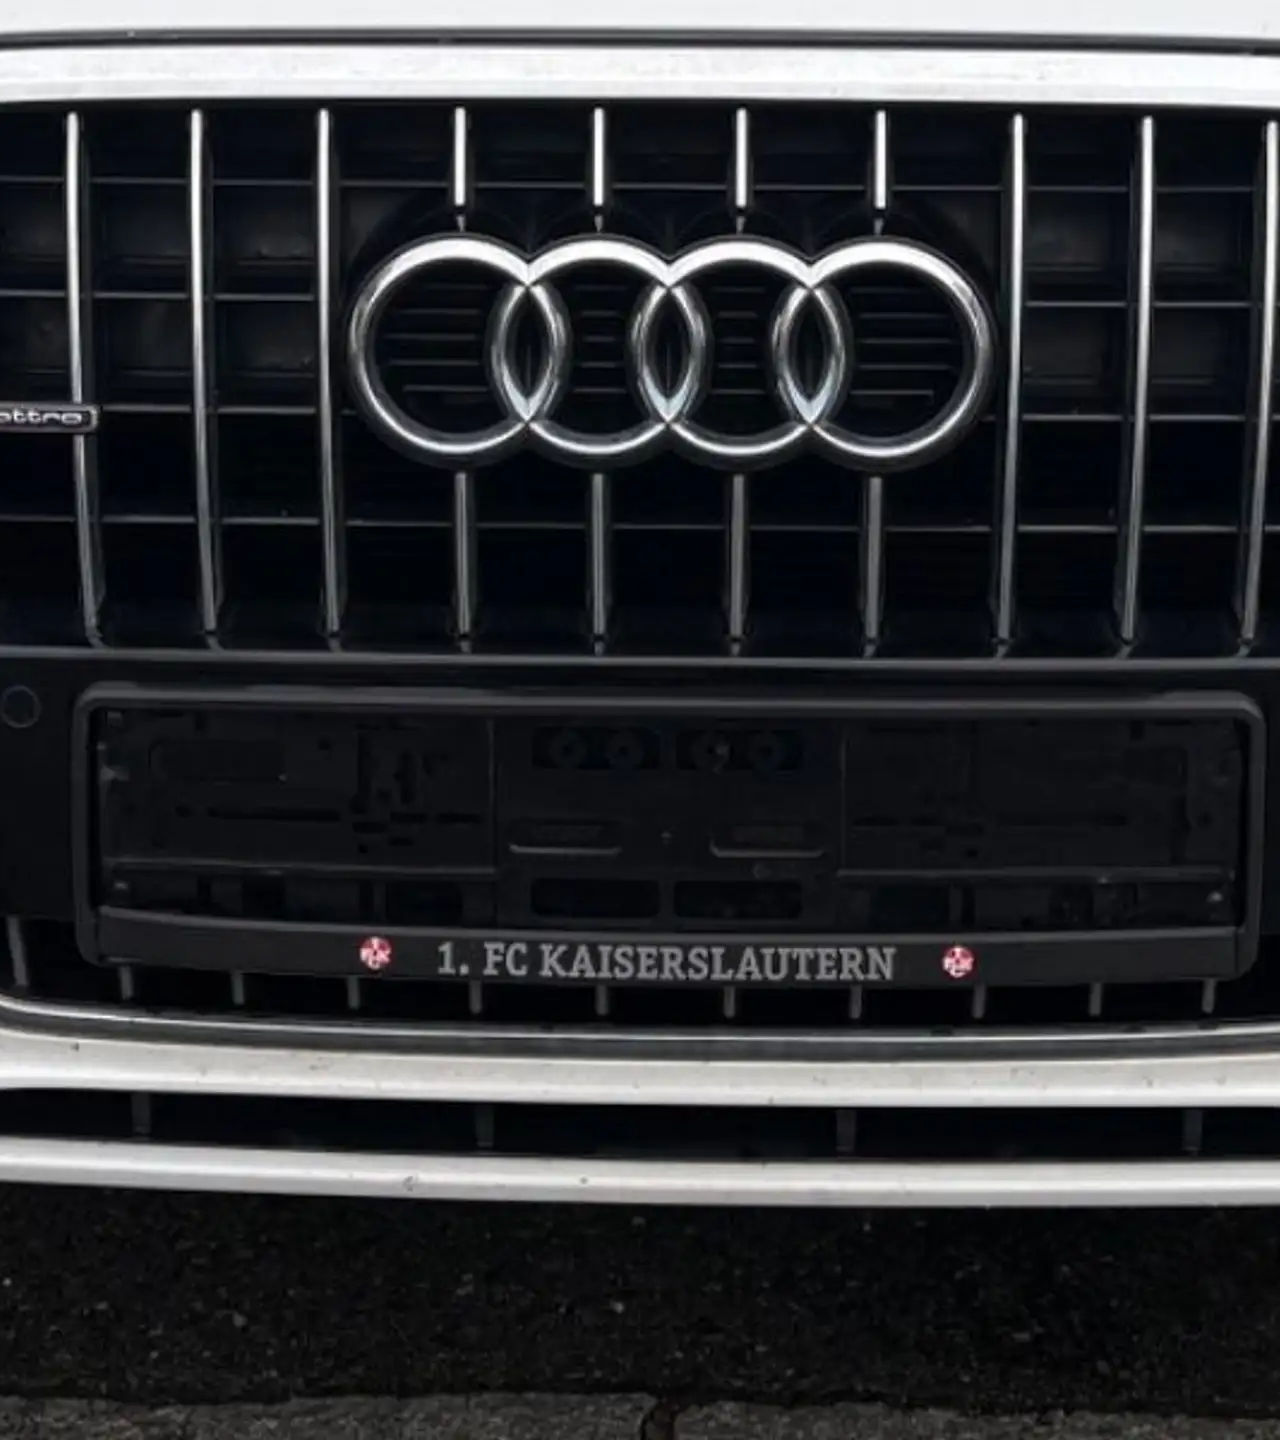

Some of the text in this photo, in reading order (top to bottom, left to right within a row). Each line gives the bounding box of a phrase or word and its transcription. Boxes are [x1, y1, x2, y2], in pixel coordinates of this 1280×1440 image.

[437, 941, 897, 981] 1. FC KAISERSLAUTERN
